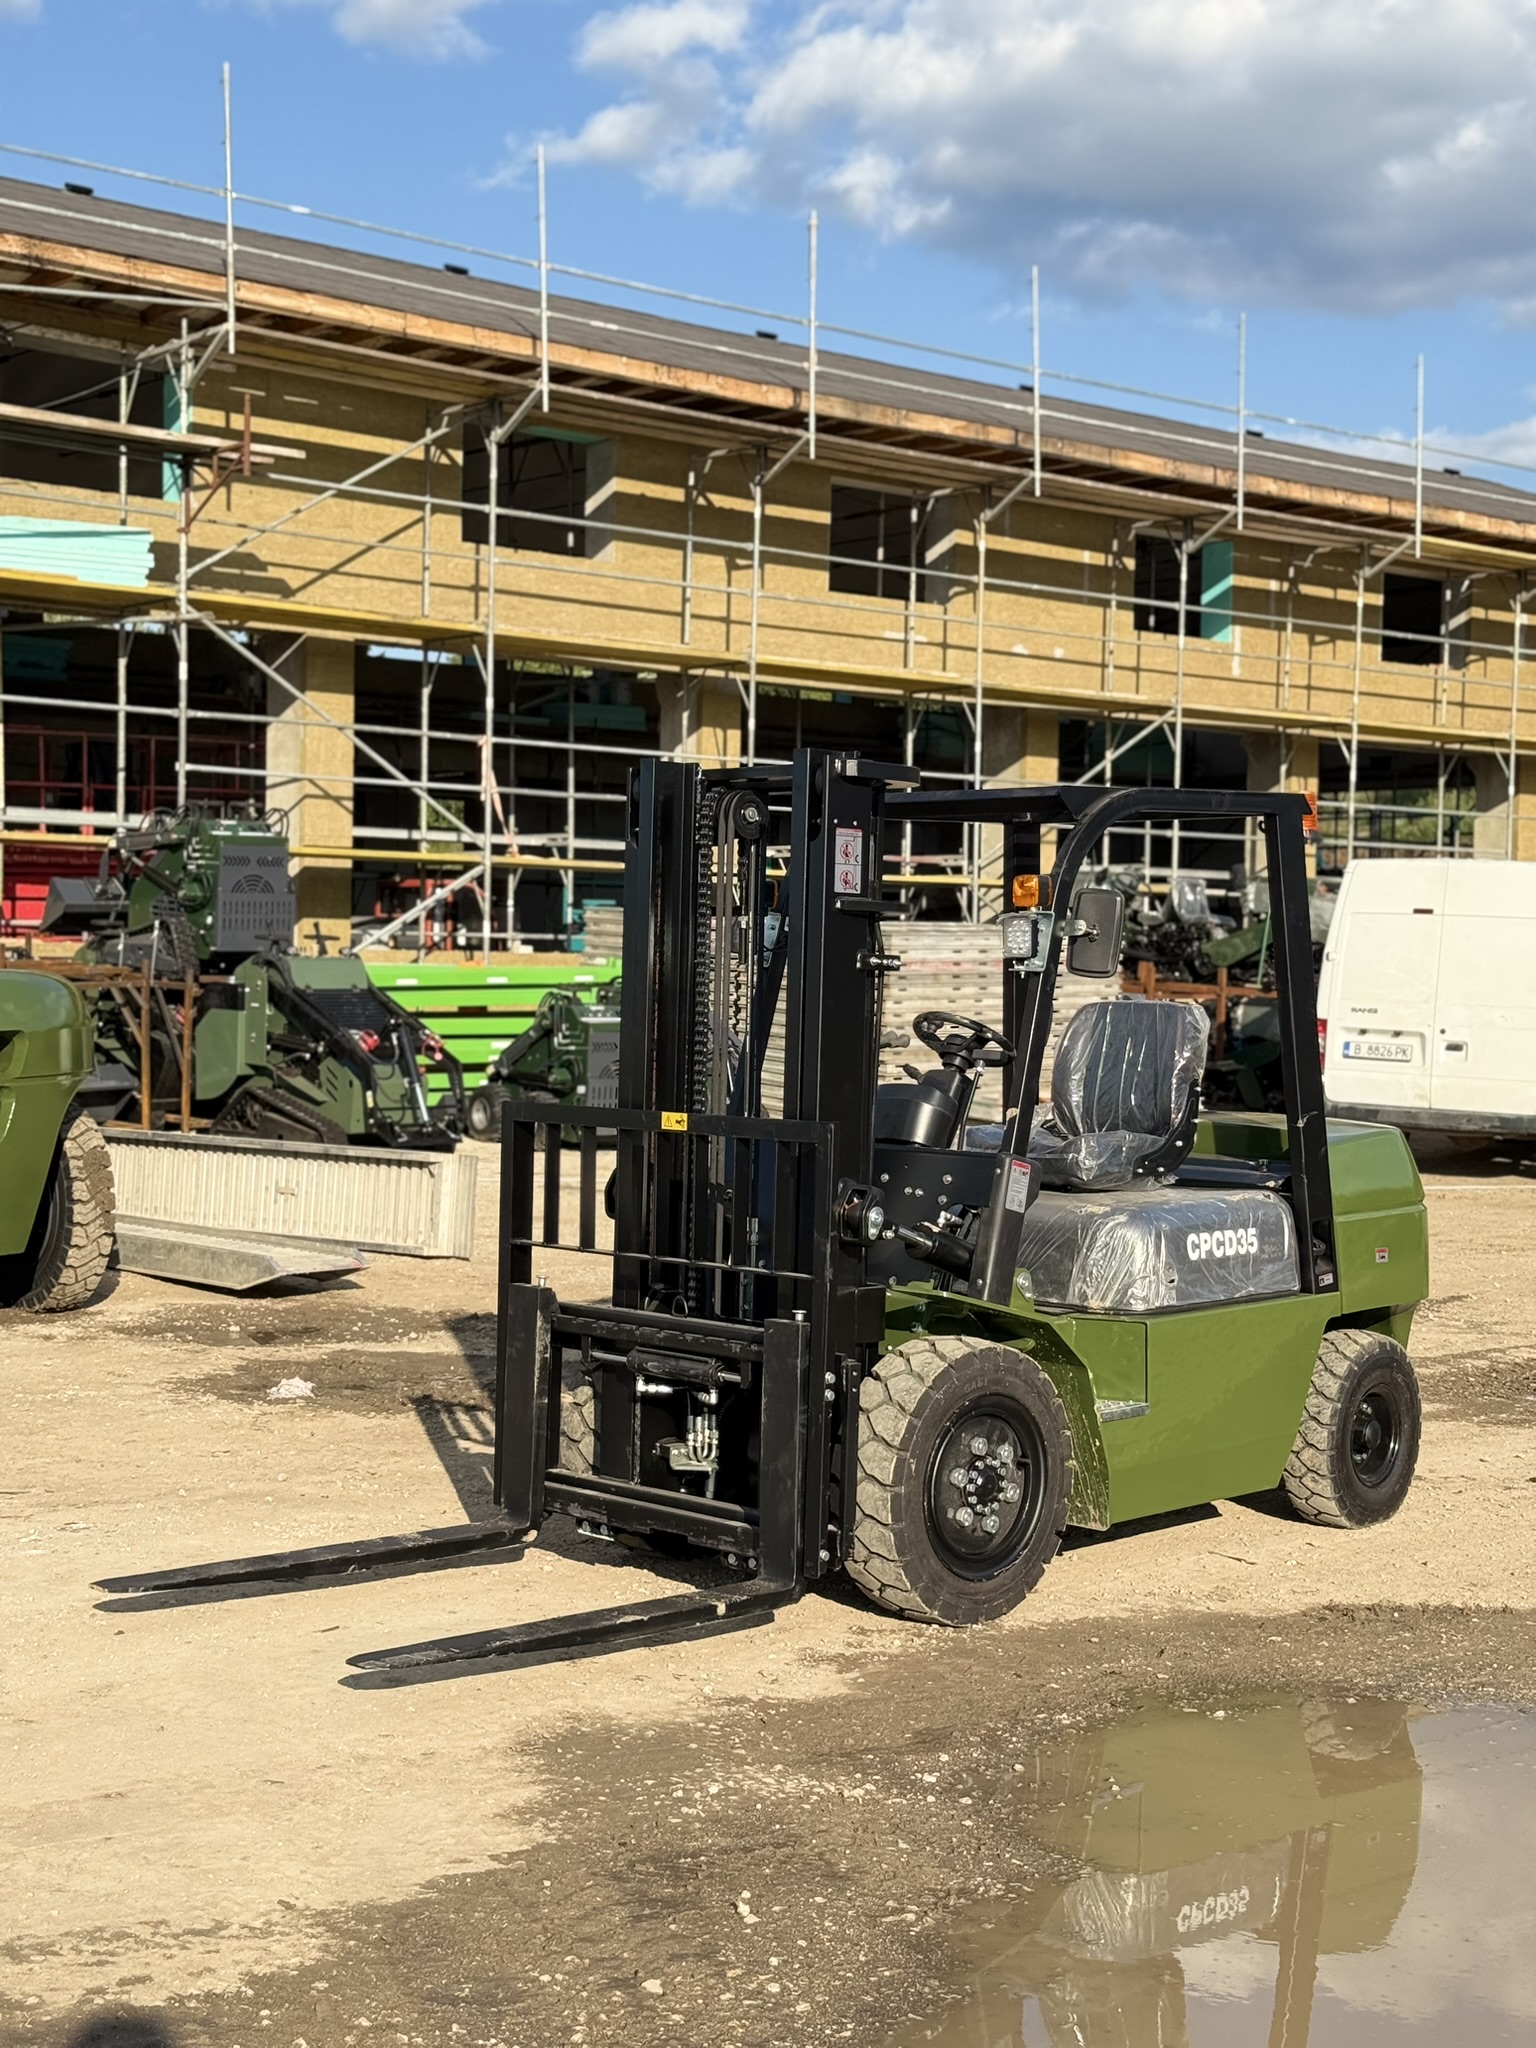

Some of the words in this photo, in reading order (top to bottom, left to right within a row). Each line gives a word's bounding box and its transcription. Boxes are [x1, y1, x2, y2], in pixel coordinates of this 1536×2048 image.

[1354, 1043, 1361, 1055] B
[1367, 1045, 1393, 1057] 8826
[1395, 1046, 1409, 1058] PK
[1186, 1227, 1258, 1261] CPCD35
